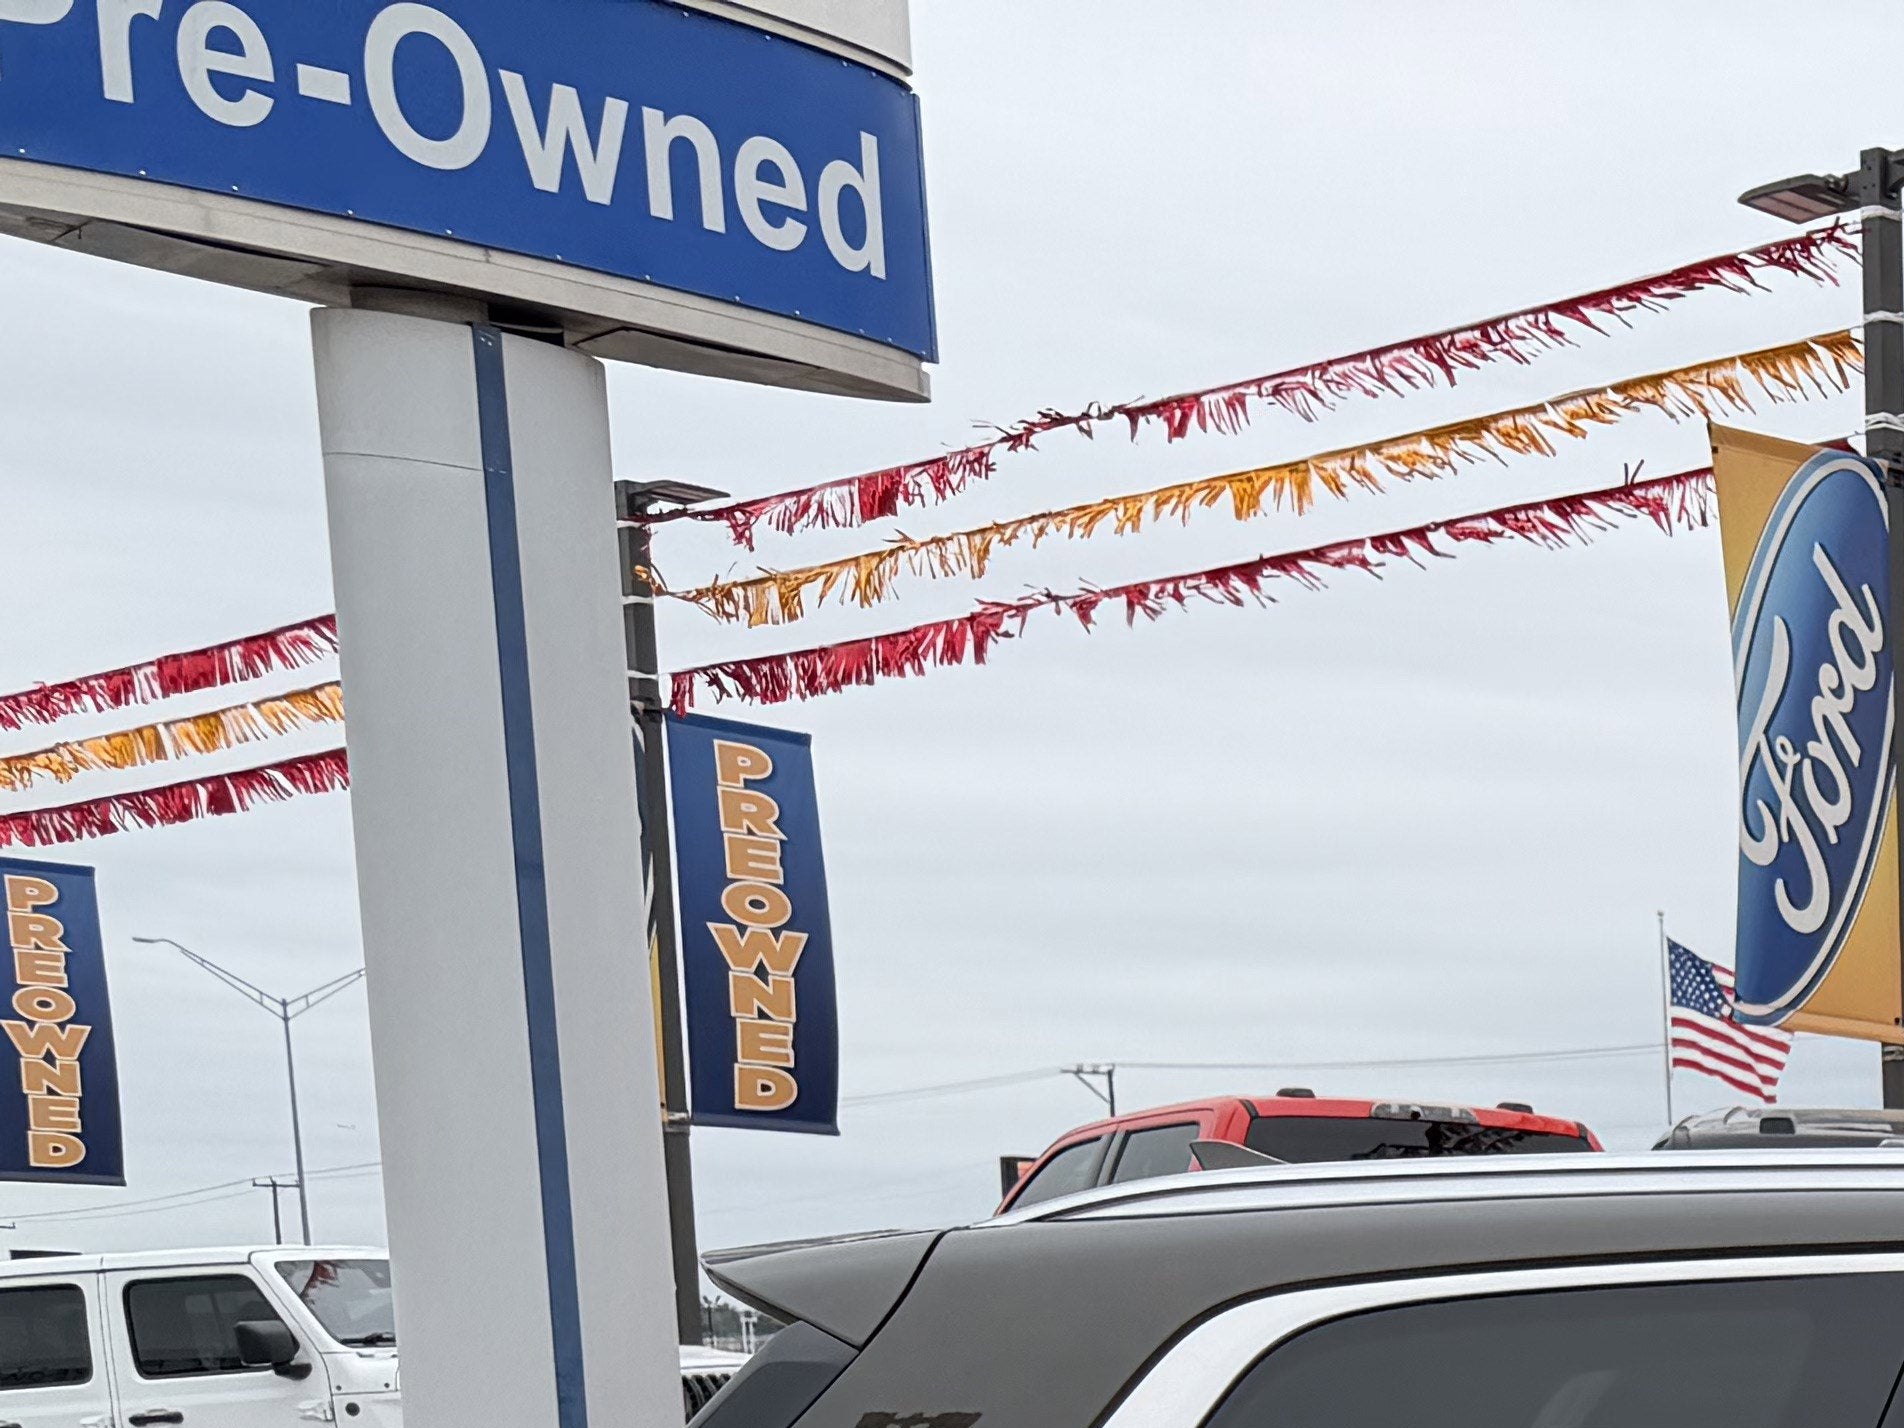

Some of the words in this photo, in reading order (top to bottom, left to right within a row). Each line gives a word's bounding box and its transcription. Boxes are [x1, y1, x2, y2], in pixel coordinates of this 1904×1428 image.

[0, 0, 888, 280] re-Owned
[1741, 542, 1887, 934] Ford
[0, 874, 92, 1168] PREOWNED
[705, 740, 808, 1112] PREOWNED
